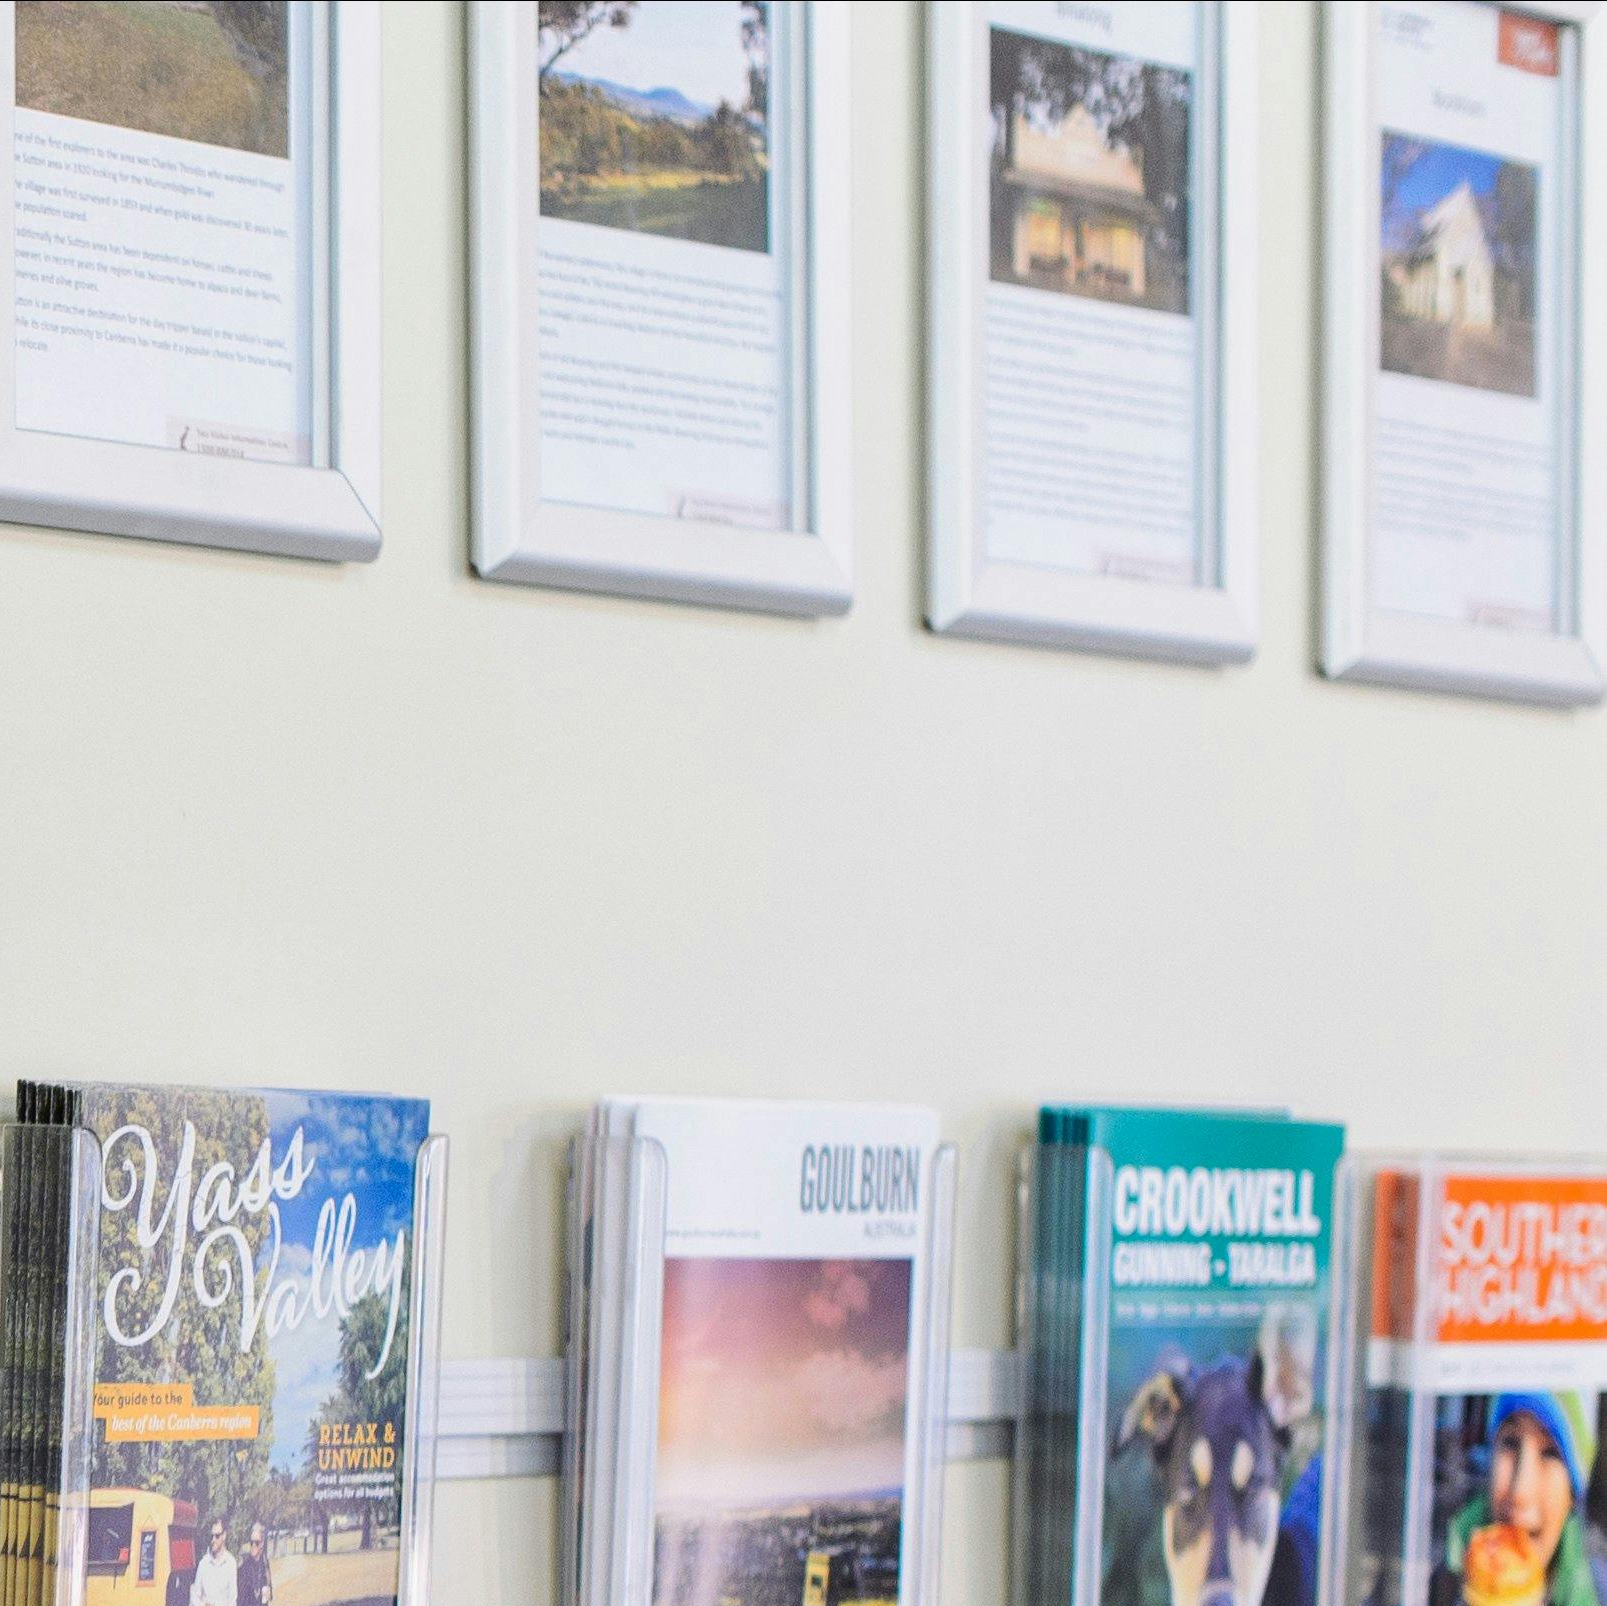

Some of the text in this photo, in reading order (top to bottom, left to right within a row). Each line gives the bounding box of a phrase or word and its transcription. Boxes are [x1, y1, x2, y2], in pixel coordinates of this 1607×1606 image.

[800, 1143, 921, 1213] GOULBURN
[1113, 1166, 1321, 1236] CROOKWELL
[100, 1121, 317, 1347] Yass
[1113, 1239, 1316, 1285] GUNNING TARALGA
[194, 1193, 405, 1380] Valley
[112, 1412, 251, 1434] best of the Canberra region
[118, 1394, 148, 1410] guide
[150, 1394, 163, 1405] to
[165, 1392, 183, 1405] the
[319, 1422, 396, 1445] RELAX &
[318, 1447, 395, 1471] UNWIND
